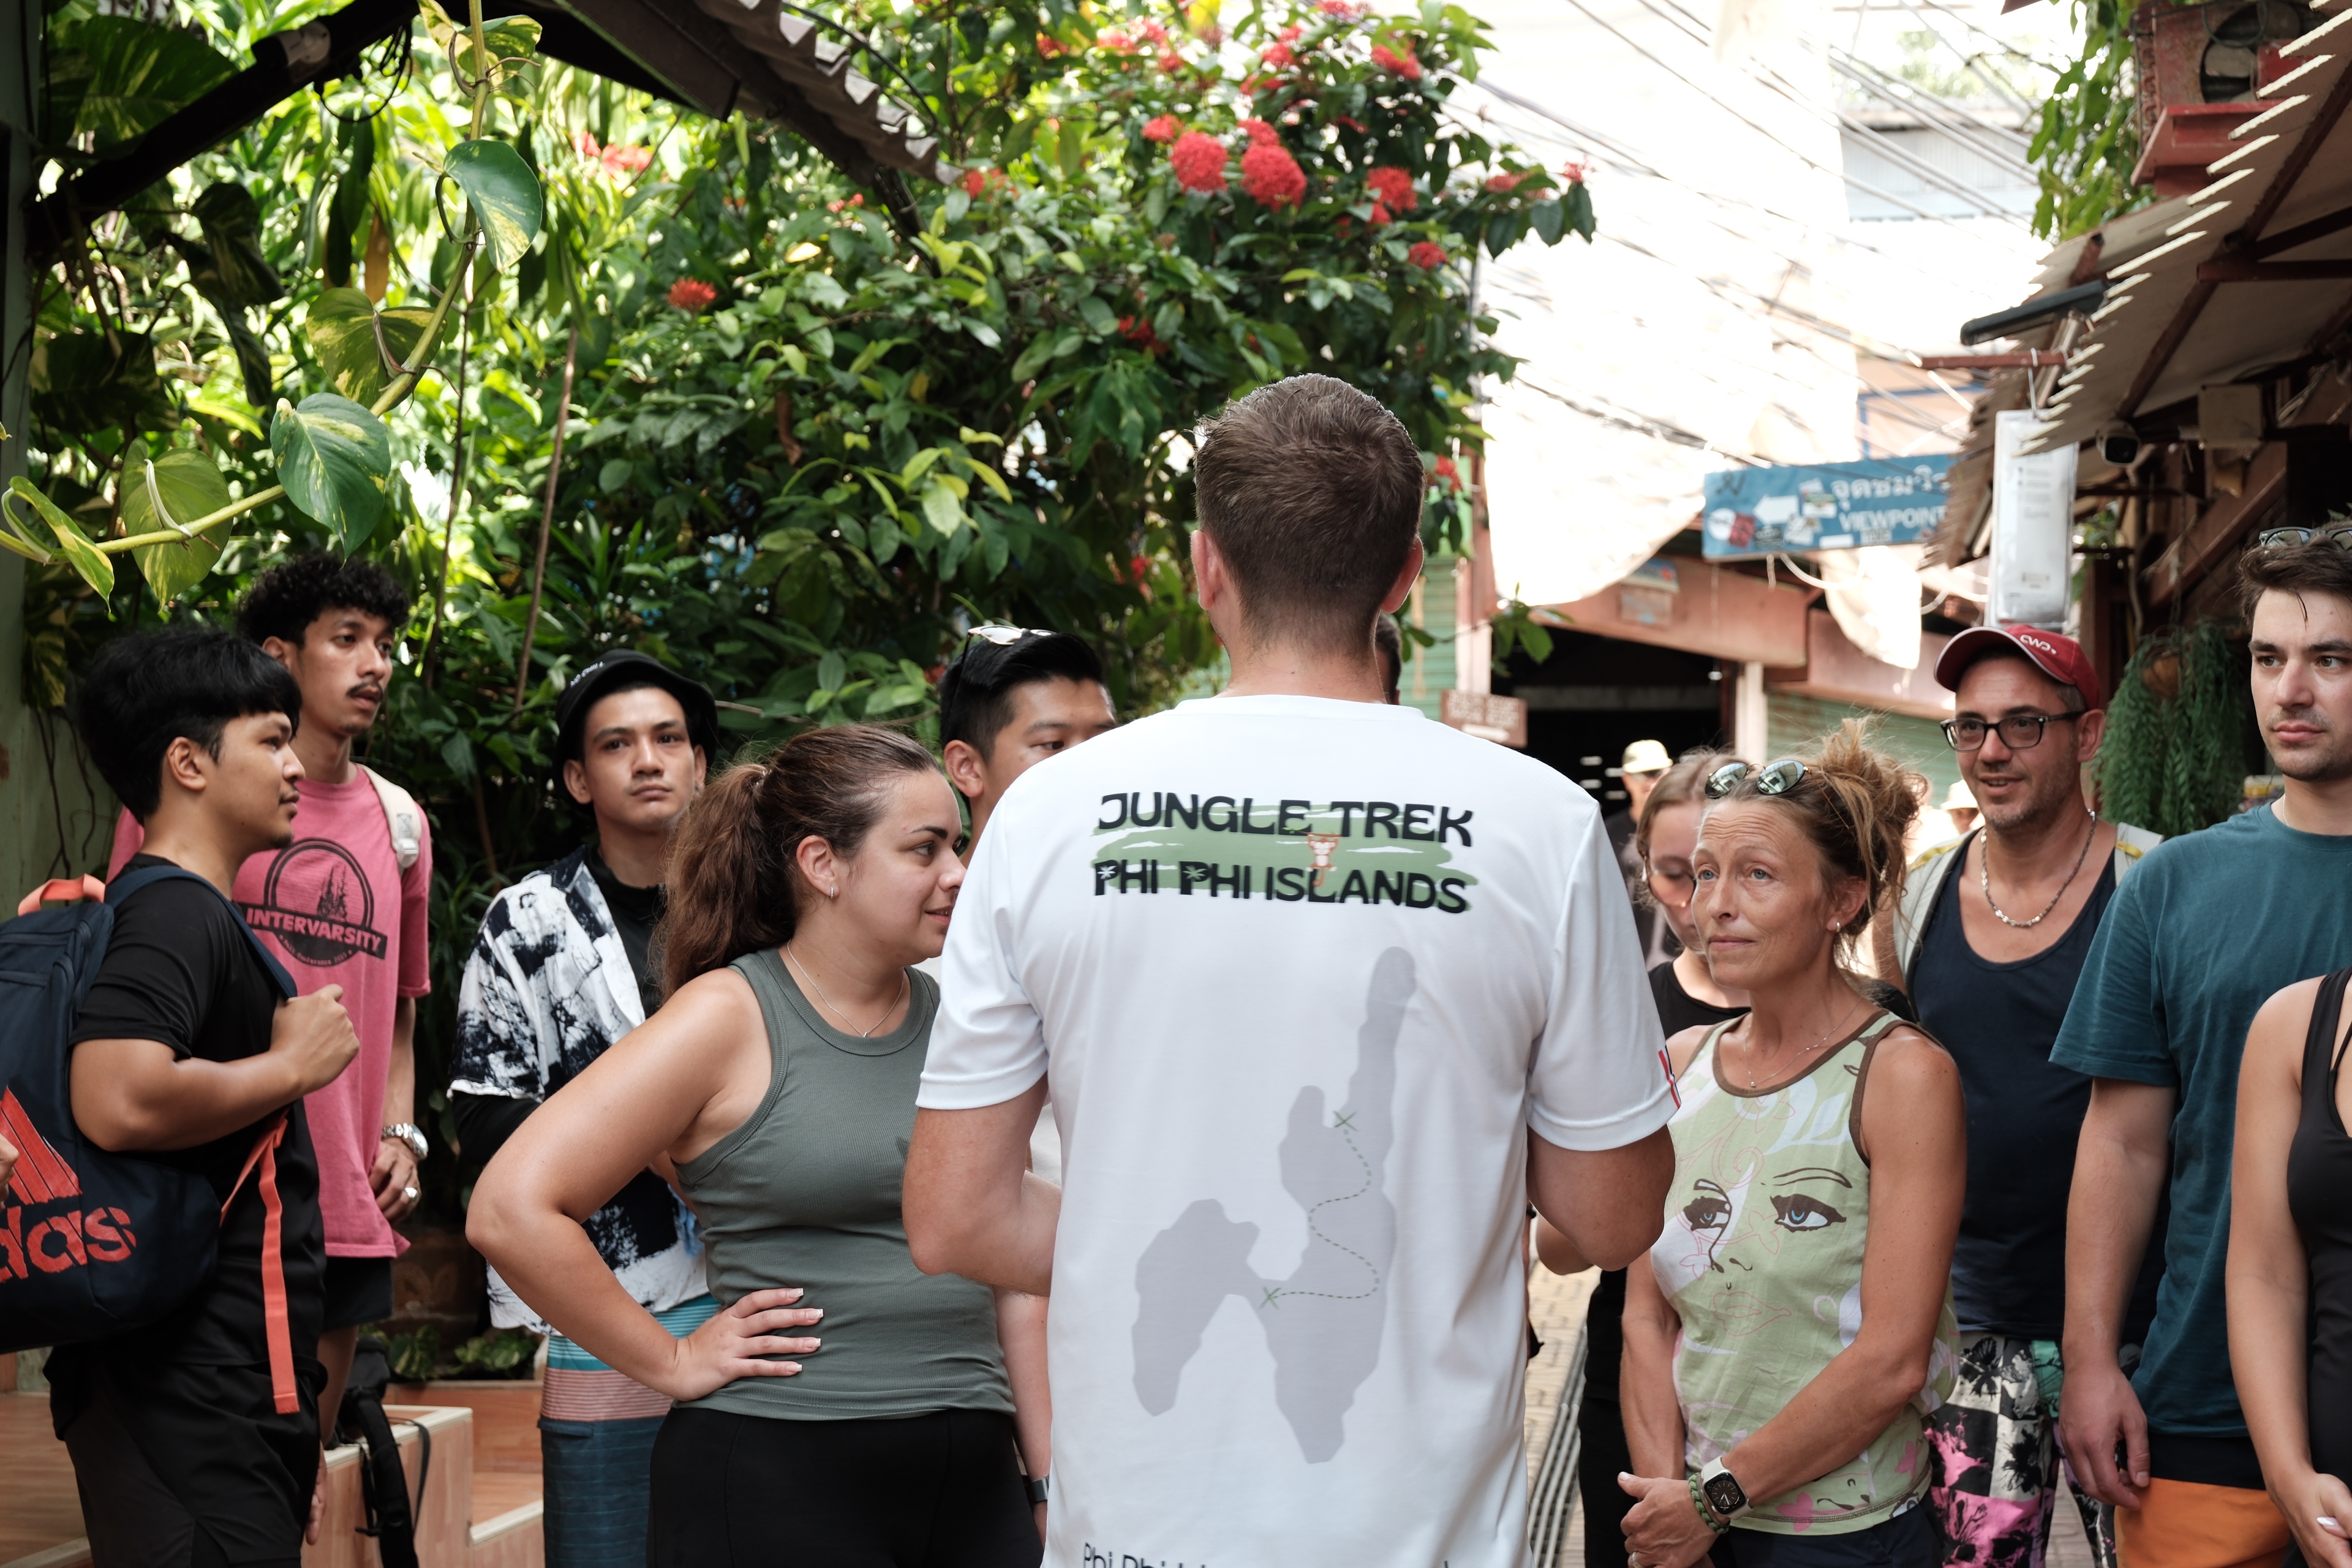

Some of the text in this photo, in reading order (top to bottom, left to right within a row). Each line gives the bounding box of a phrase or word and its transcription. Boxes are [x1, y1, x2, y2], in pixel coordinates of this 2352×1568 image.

[1099, 791, 1473, 848] JUNGLE TREK
[1095, 858, 1467, 914] PHI PHI ISLANDS
[246, 908, 382, 952] INTERVARSITY
